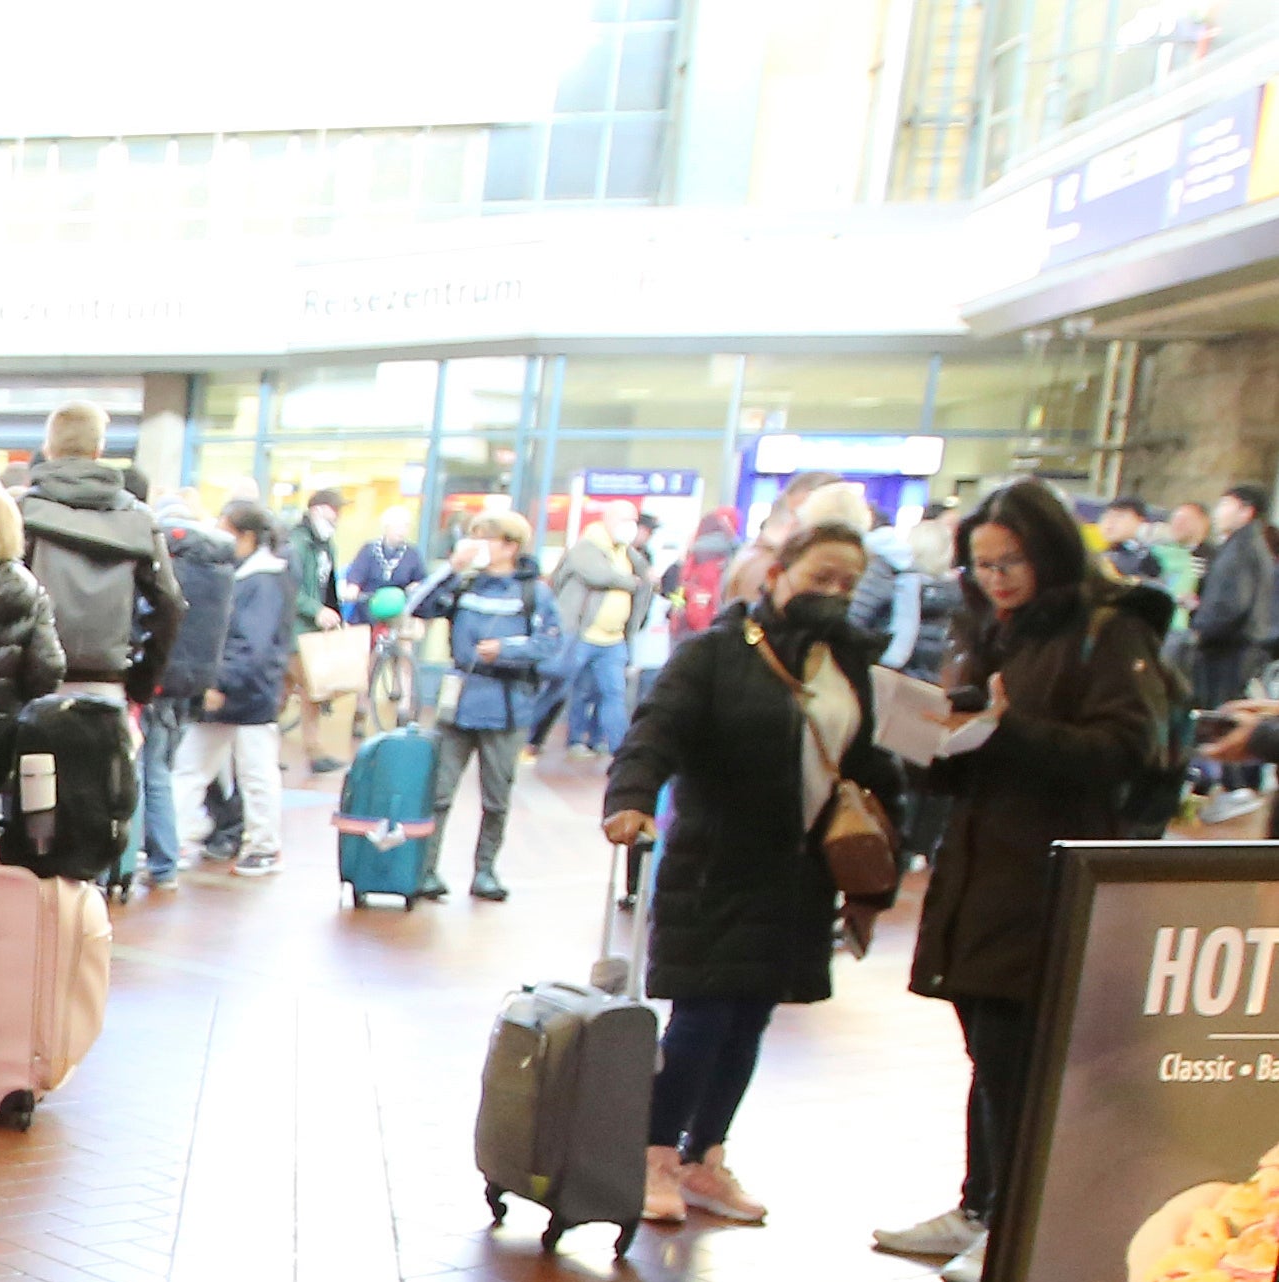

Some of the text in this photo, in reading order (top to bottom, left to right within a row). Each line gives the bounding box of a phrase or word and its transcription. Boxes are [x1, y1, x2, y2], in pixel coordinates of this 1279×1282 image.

[301, 276, 524, 317] Reisezentrum
[1142, 926, 1279, 1017] HOT
[1158, 1052, 1236, 1082] Classic
